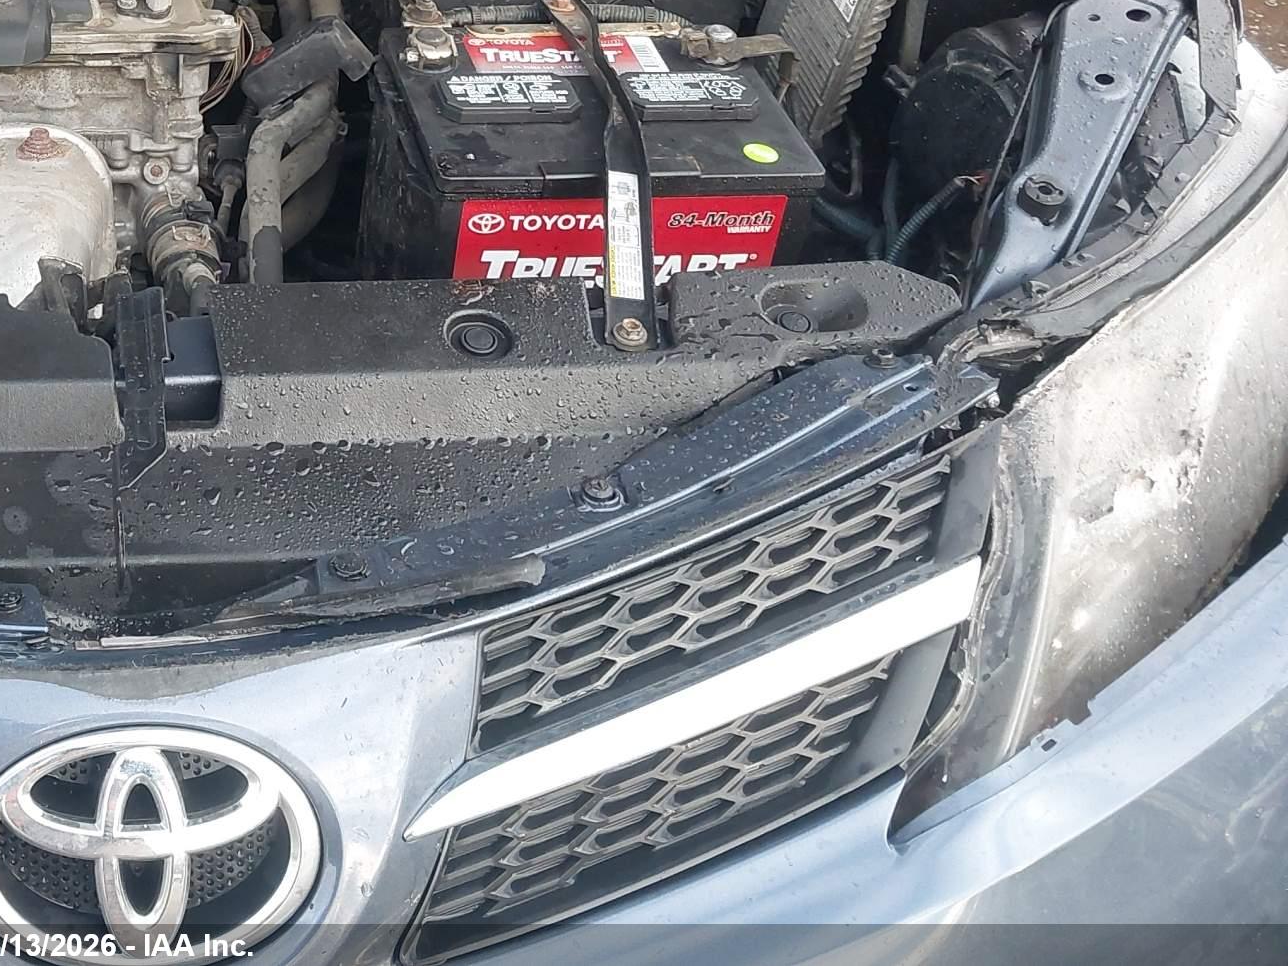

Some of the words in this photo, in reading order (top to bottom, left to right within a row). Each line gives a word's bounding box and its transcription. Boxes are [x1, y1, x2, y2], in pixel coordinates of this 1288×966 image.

[509, 214, 605, 231] TOYOTA
[668, 211, 775, 228] 84-Month
[727, 225, 772, 233] WARRANTY
